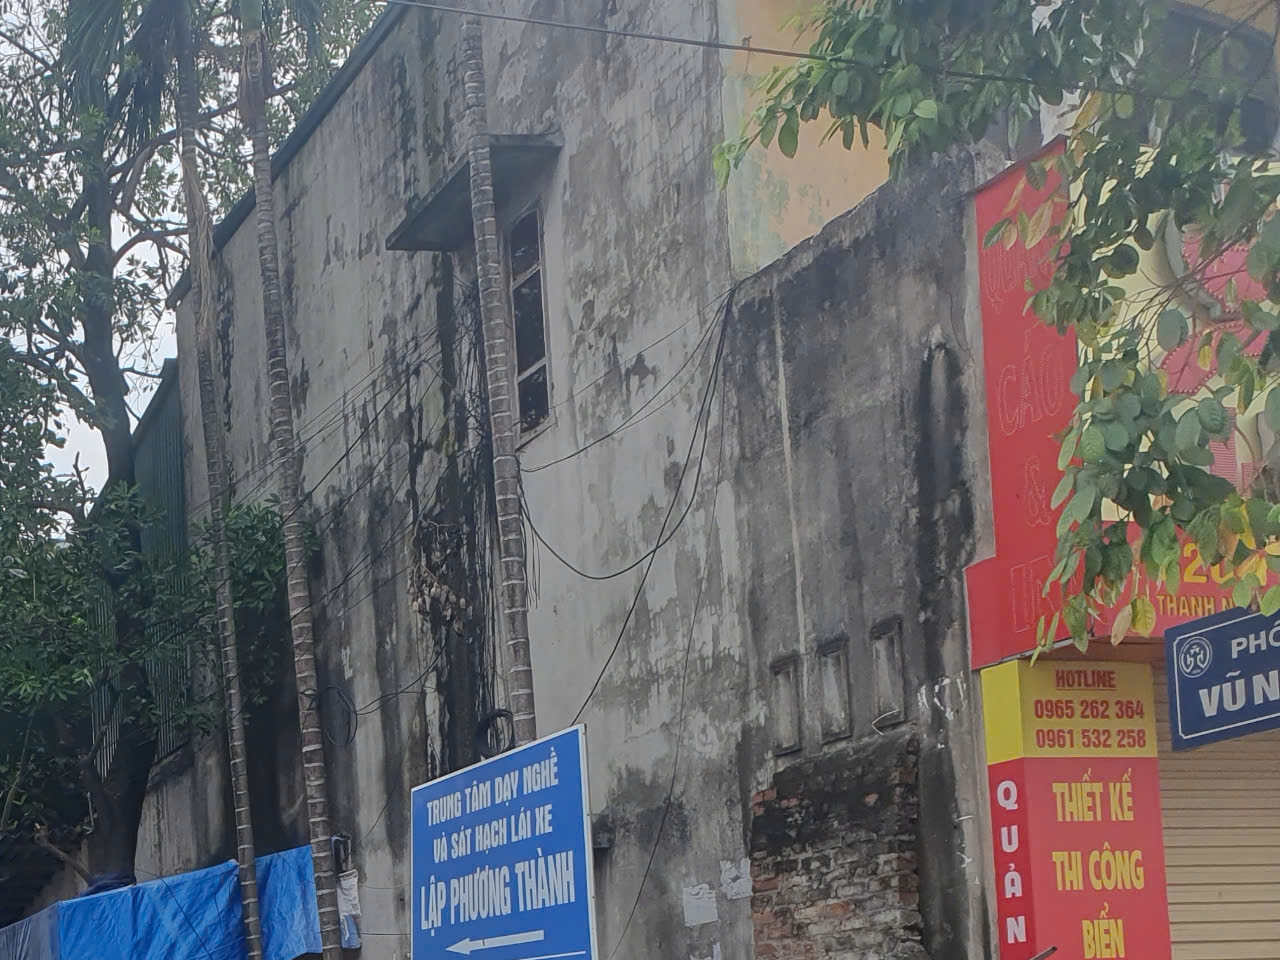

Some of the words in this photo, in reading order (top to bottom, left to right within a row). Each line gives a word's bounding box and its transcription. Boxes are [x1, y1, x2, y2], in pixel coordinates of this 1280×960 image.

[1055, 669, 1117, 689] HOTLINE
[1198, 670, 1246, 718] VŨ
[1034, 699, 1075, 719] 0965
[1080, 699, 1110, 719] 262
[1114, 699, 1144, 719] 364
[1035, 728, 1075, 748] 0961
[1081, 728, 1112, 748] 532
[1116, 728, 1147, 748] 258
[426, 791, 462, 827] TRUNG
[465, 779, 492, 814] TÂM
[494, 769, 519, 808] DẠY
[522, 746, 559, 793] NGHỀ
[1052, 767, 1103, 822] THIẾT
[1109, 767, 1135, 822] KẾ
[433, 831, 448, 864] VÀ
[451, 820, 472, 859] SÁT
[475, 814, 507, 855] HẠCH
[510, 807, 531, 843] LÁI
[535, 803, 553, 835] XE
[1052, 851, 1084, 890] THI
[1088, 841, 1145, 890] CÔNG
[420, 875, 447, 937] LẬP
[450, 863, 513, 926] PHƯƠNG
[514, 847, 576, 913] THÀNH
[1082, 902, 1125, 960] BIỂN
